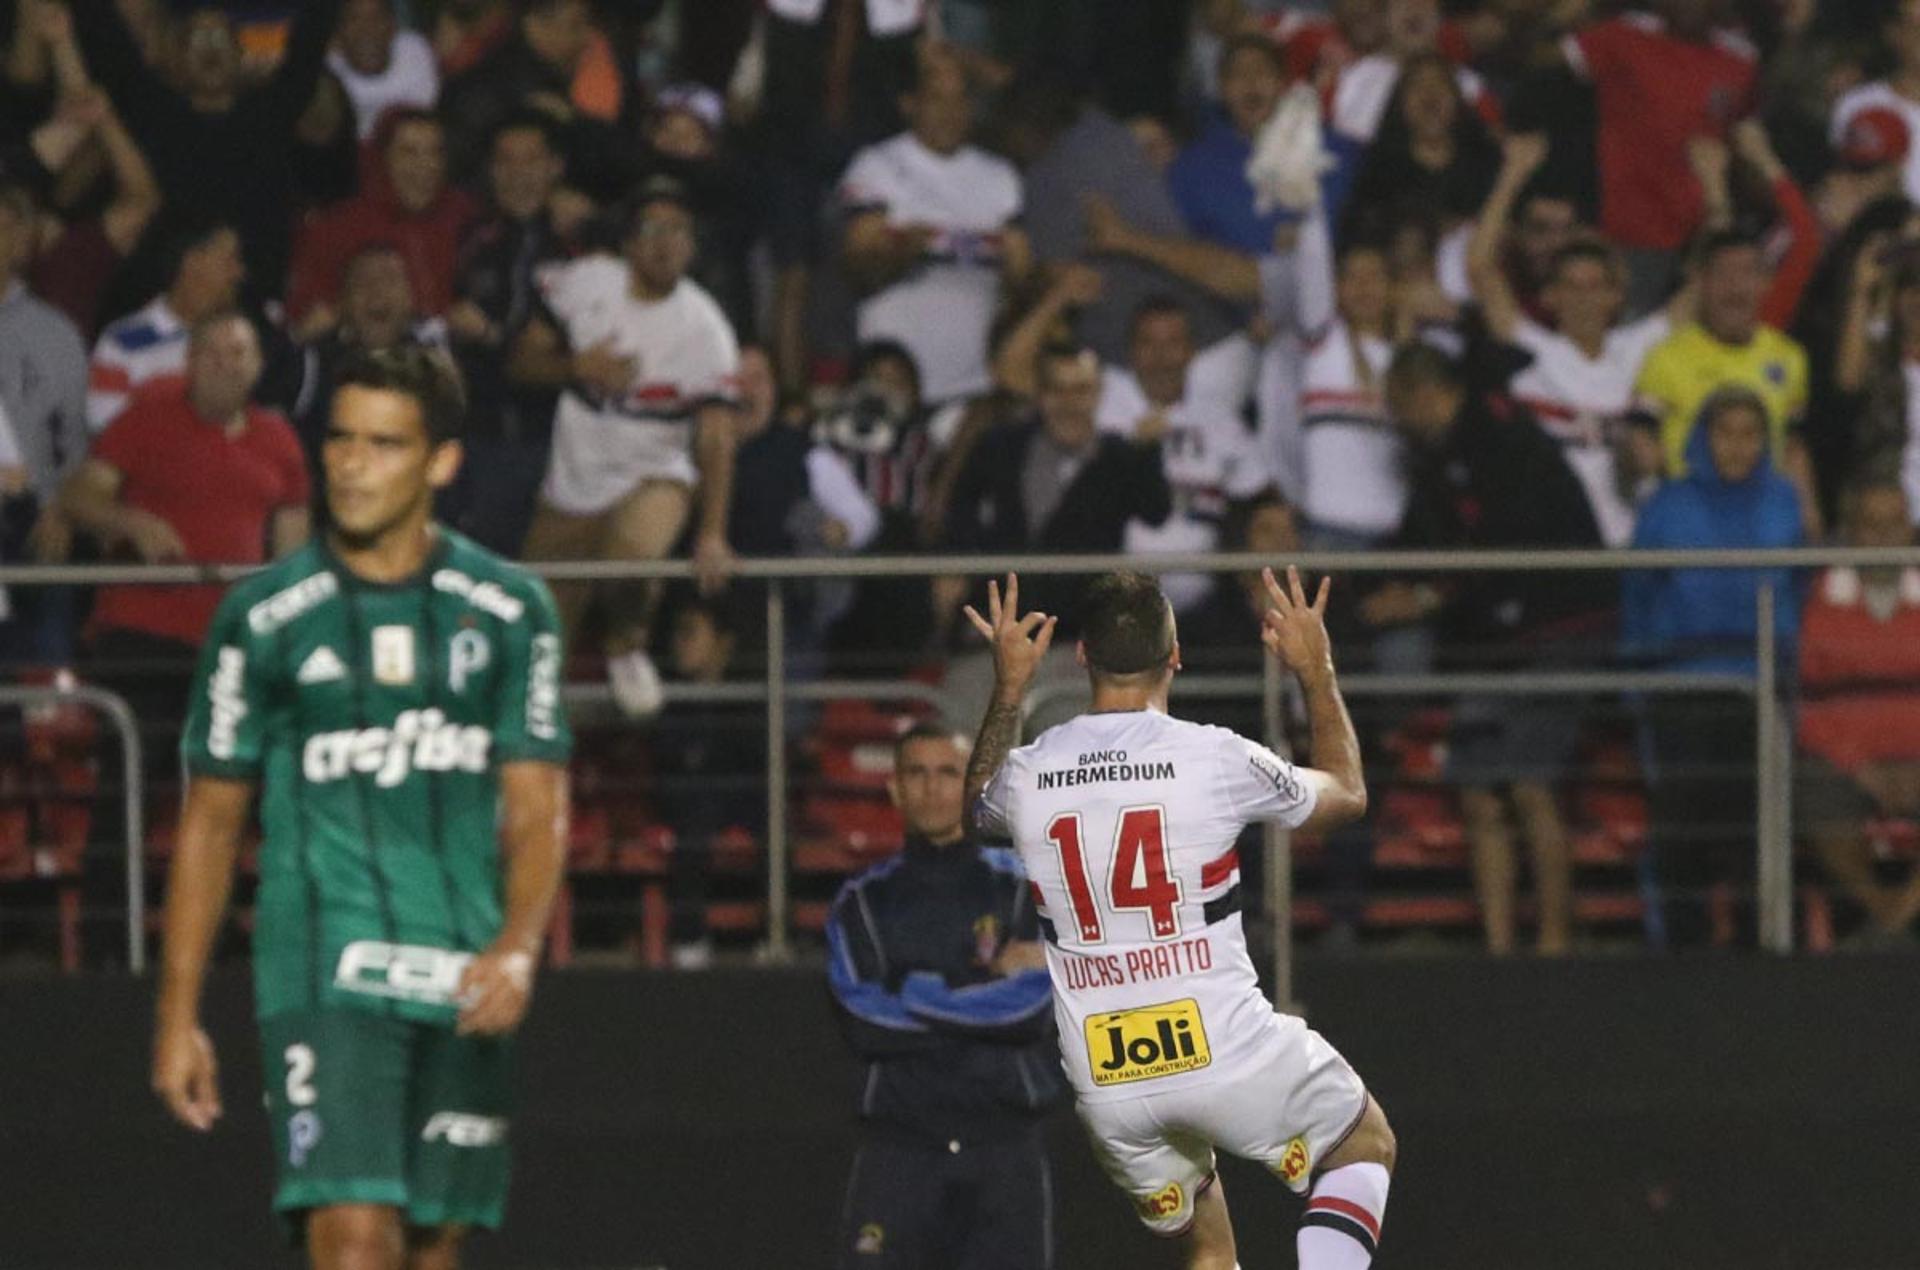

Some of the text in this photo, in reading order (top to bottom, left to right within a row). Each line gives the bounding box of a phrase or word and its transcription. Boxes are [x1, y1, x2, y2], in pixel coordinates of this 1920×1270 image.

[1037, 762, 1175, 790] INTERMEDIUM
[1078, 750, 1128, 766] BANCO
[1045, 803, 1184, 945] 14
[1063, 938, 1213, 991] LUCAS PRATTO
[1101, 1018, 1196, 1071] Joli
[1118, 1068, 1144, 1080] PARA
[1144, 1056, 1208, 1077] CONSTRUÇÃO
[284, 1043, 316, 1106] 2
